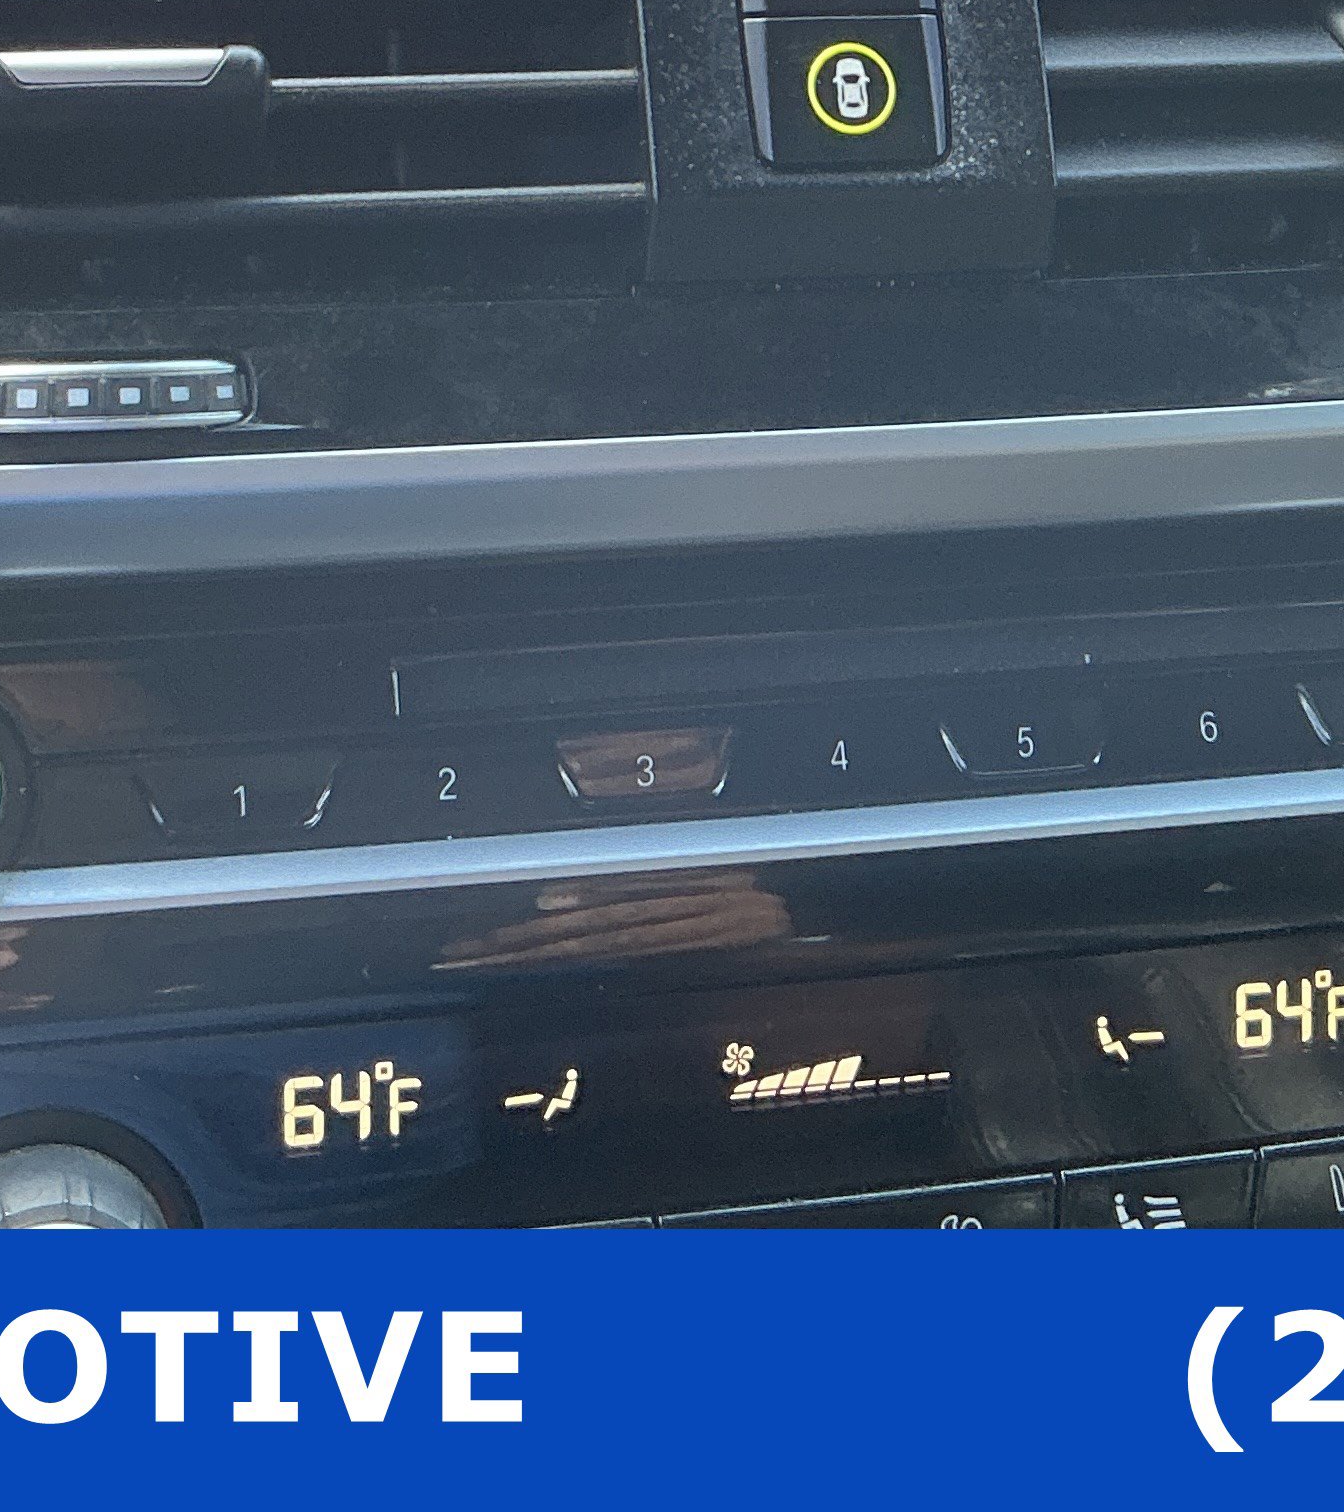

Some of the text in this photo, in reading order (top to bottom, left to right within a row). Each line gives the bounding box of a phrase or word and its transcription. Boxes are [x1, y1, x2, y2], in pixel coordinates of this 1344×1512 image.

[233, 786, 246, 816] 1
[438, 768, 457, 799] 2
[636, 755, 655, 786] 3
[831, 740, 849, 771] 4
[1017, 727, 1034, 758] 5
[1200, 712, 1218, 741] 6
